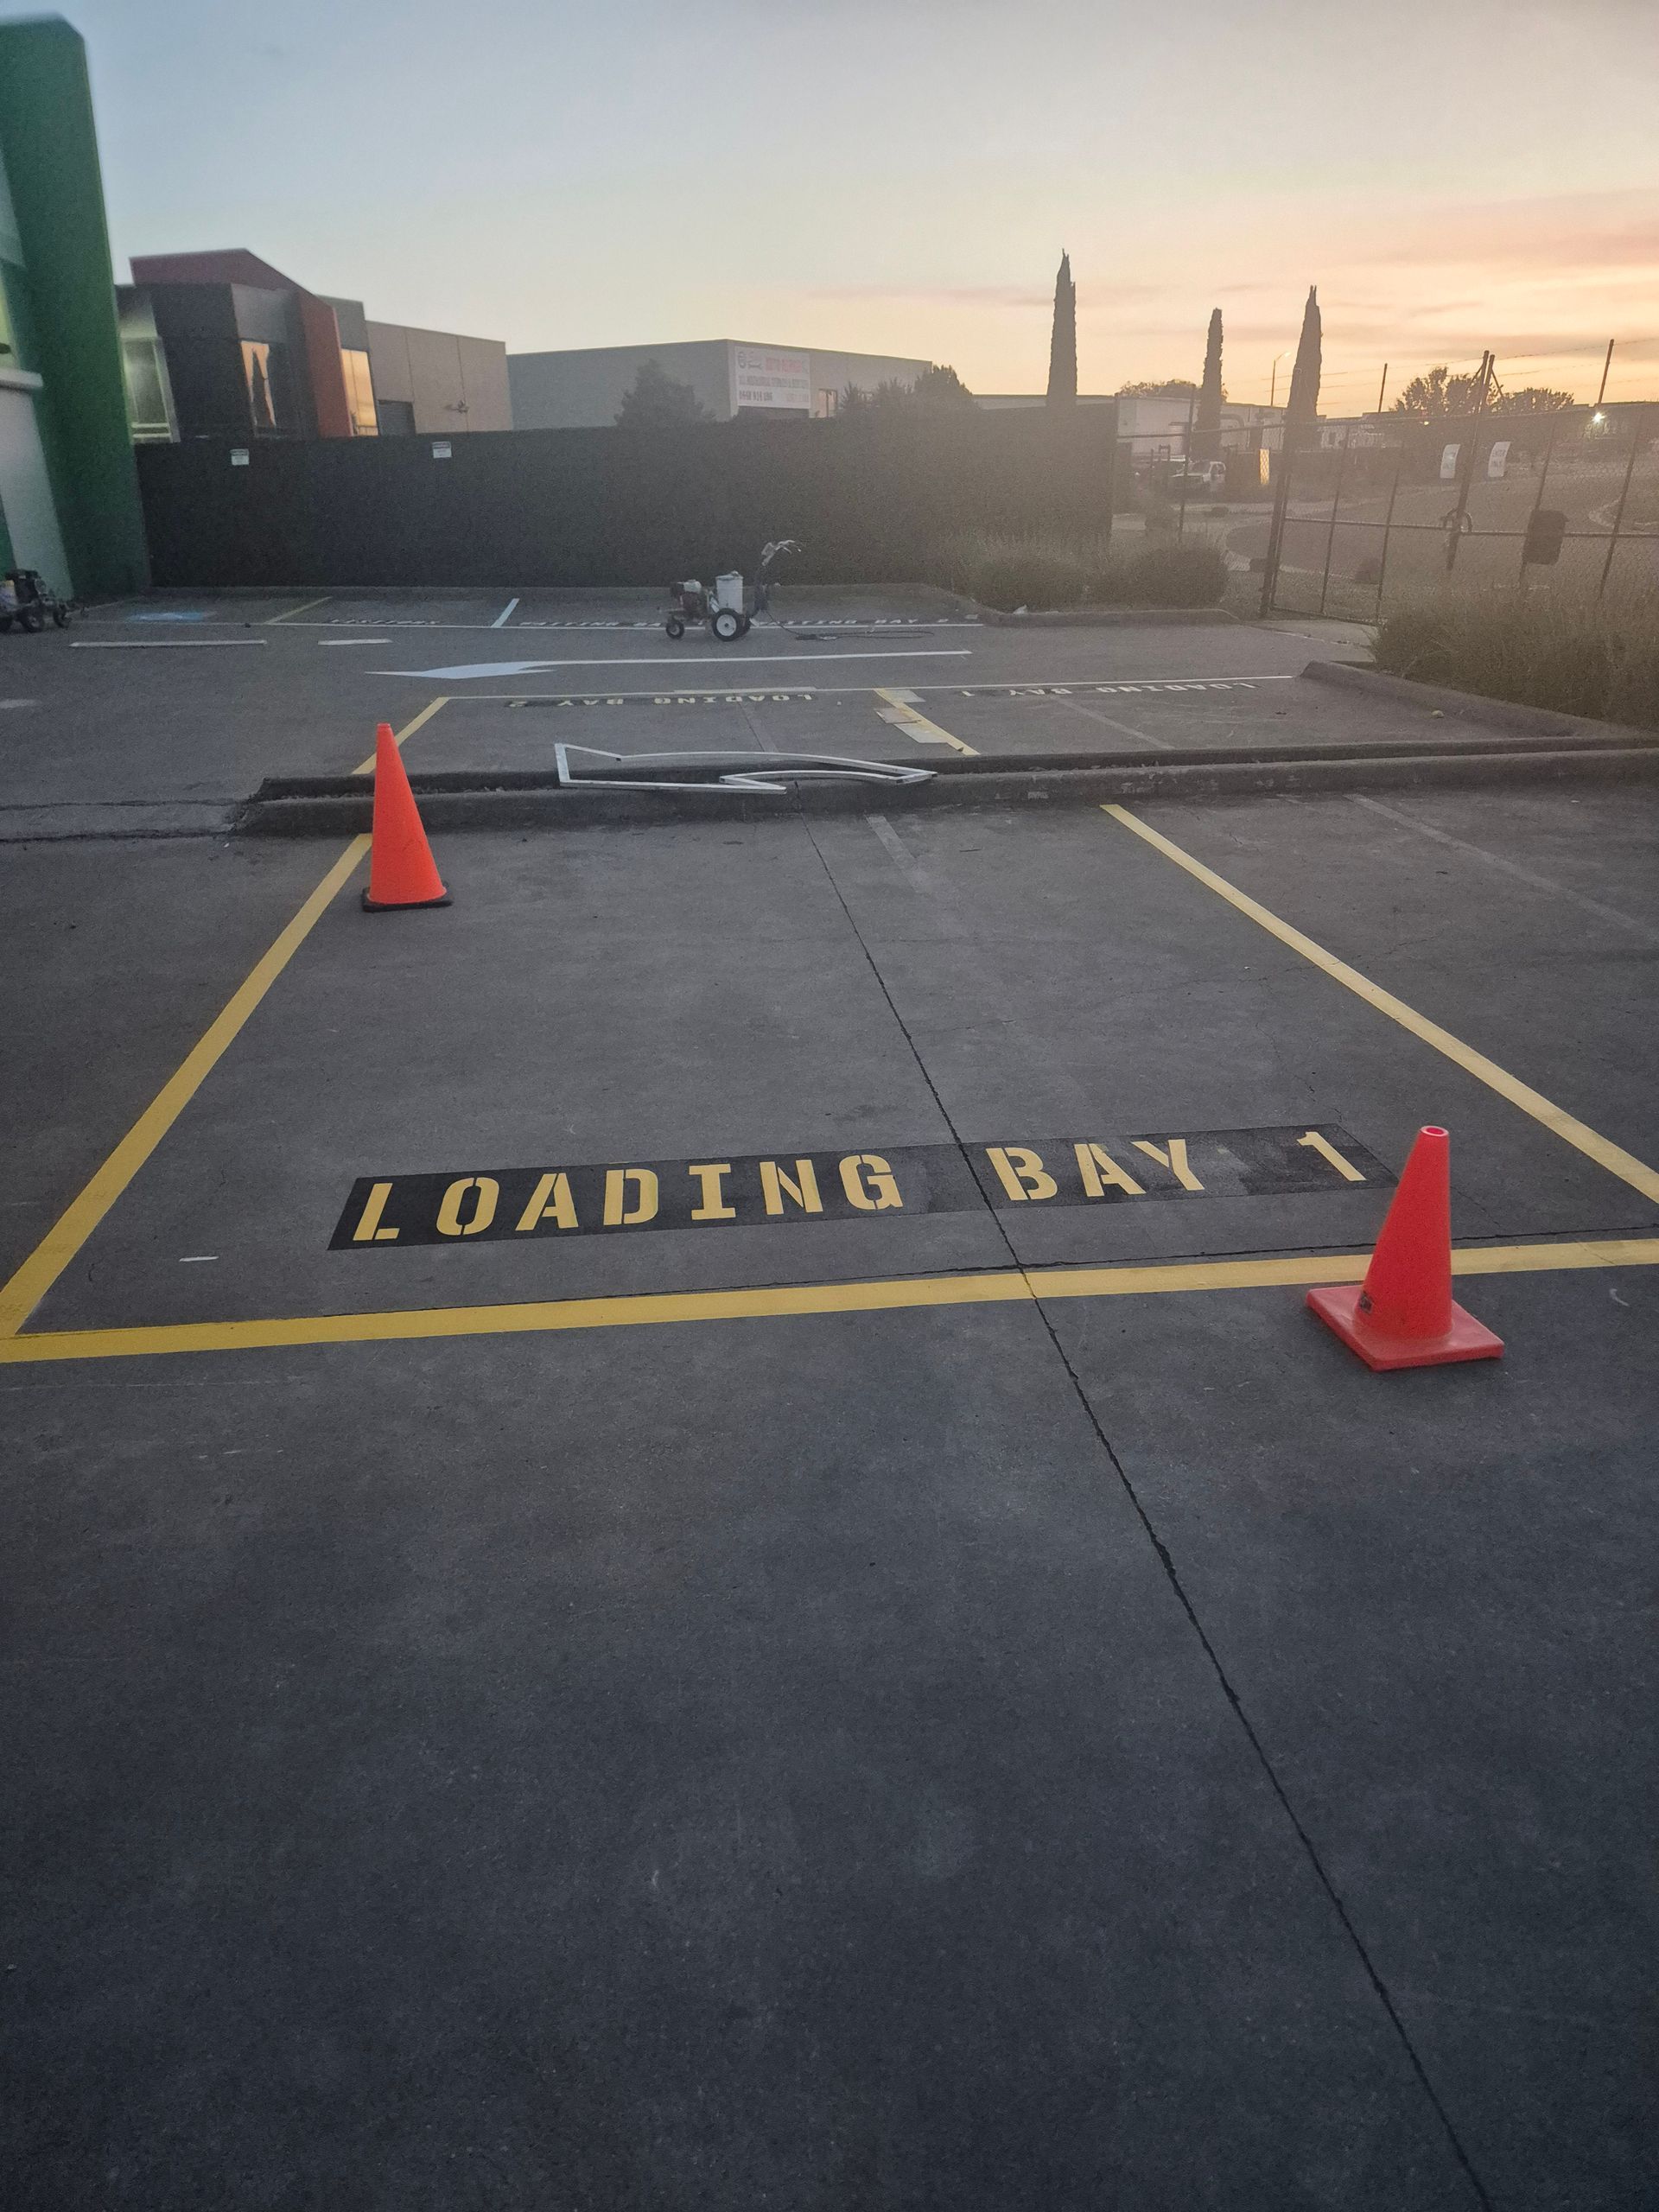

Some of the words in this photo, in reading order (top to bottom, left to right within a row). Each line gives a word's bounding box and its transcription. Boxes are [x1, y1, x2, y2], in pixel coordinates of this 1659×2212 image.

[1095, 682, 1257, 693] LOADING
[557, 697, 625, 707] BAY
[653, 694, 814, 705] LOADING
[352, 1155, 903, 1242] LOADING
[986, 1141, 1203, 1202] BAY
[1297, 1130, 1366, 1183] 1
